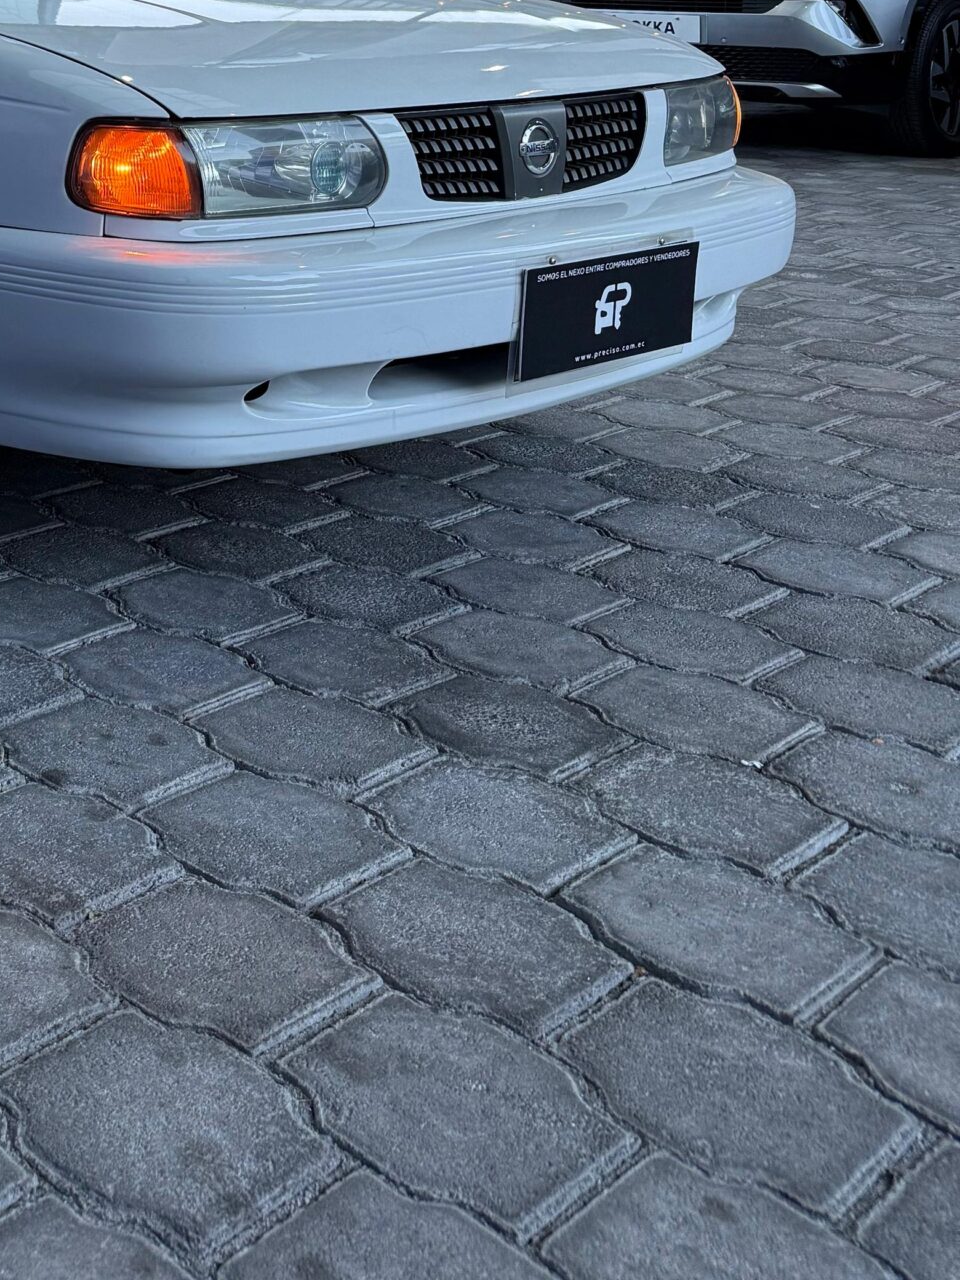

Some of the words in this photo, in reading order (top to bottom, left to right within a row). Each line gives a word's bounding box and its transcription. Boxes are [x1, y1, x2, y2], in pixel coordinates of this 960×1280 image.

[537, 271, 560, 282] SOMOS
[560, 270, 568, 279] EL
[568, 267, 585, 277] NEXO
[585, 263, 605, 274] ENTRE
[605, 256, 648, 270] COMPRADORES
[649, 254, 655, 262] Y
[653, 248, 691, 262] VENDEDORES
[574, 341, 645, 362] www.preciso.com.ec
